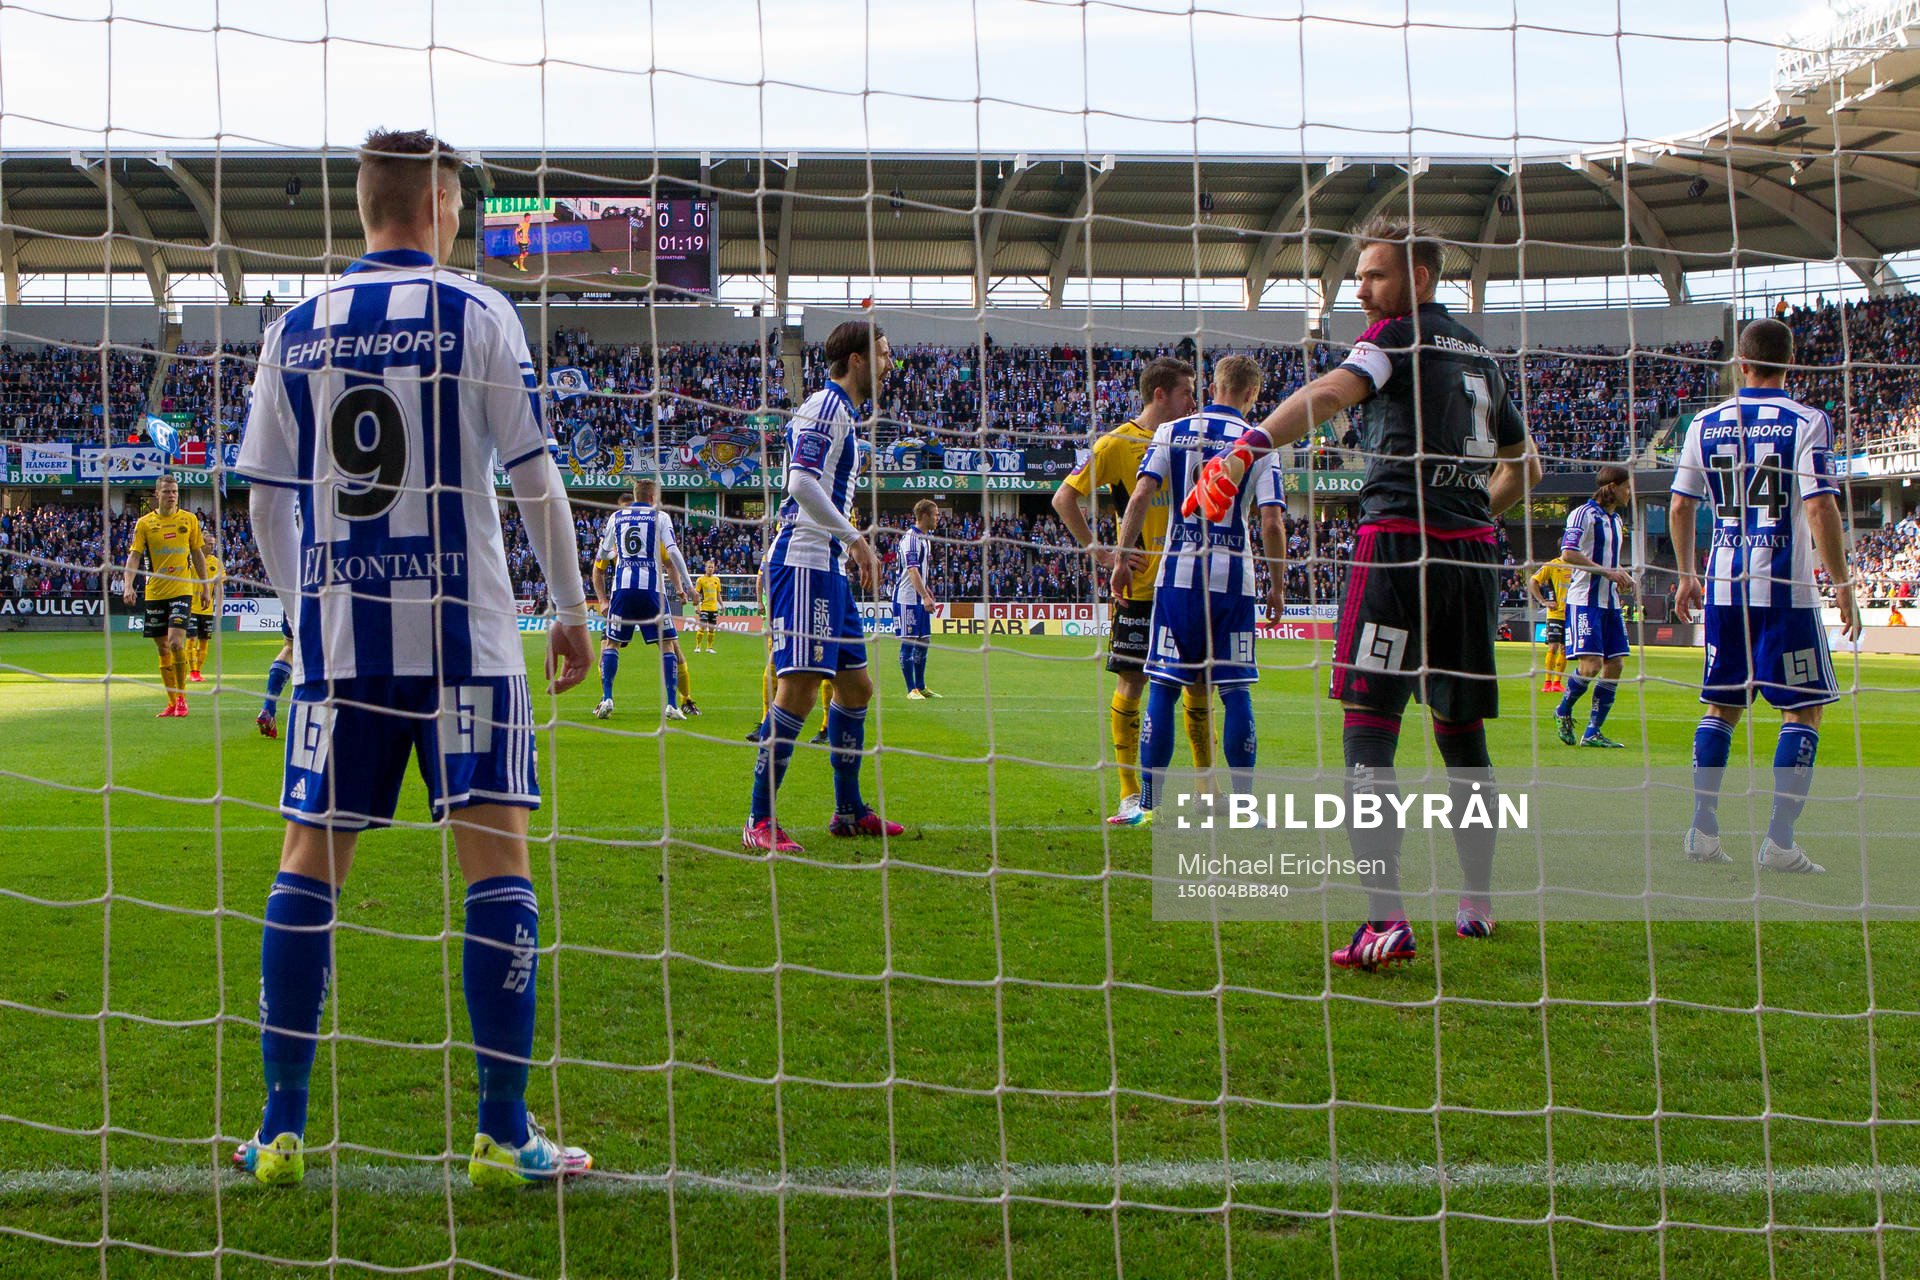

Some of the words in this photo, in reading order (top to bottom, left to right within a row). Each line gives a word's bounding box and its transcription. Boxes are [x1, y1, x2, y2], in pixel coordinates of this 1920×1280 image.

[656, 203, 669, 211] IFK
[694, 203, 707, 211] IFE
[659, 213, 669, 227] 0
[694, 213, 704, 227] 0
[659, 235, 704, 250] 01:19
[285, 330, 457, 367] EHRENBORG
[1462, 372, 1498, 458] 1
[1703, 425, 1793, 440] EHRENBORG
[331, 384, 411, 521] 9
[25, 461, 68, 469] HANGERZ
[10, 470, 46, 483] BRO
[173, 471, 208, 484] BRO
[1314, 477, 1365, 491] ÅBRO
[1709, 453, 1789, 523] 14
[624, 525, 643, 556] 6
[331, 552, 464, 582] KONTAKT
[36, 599, 104, 615] ULLEVI
[222, 601, 256, 615] park
[814, 598, 829, 612] SE
[992, 607, 1090, 619] CRAMO
